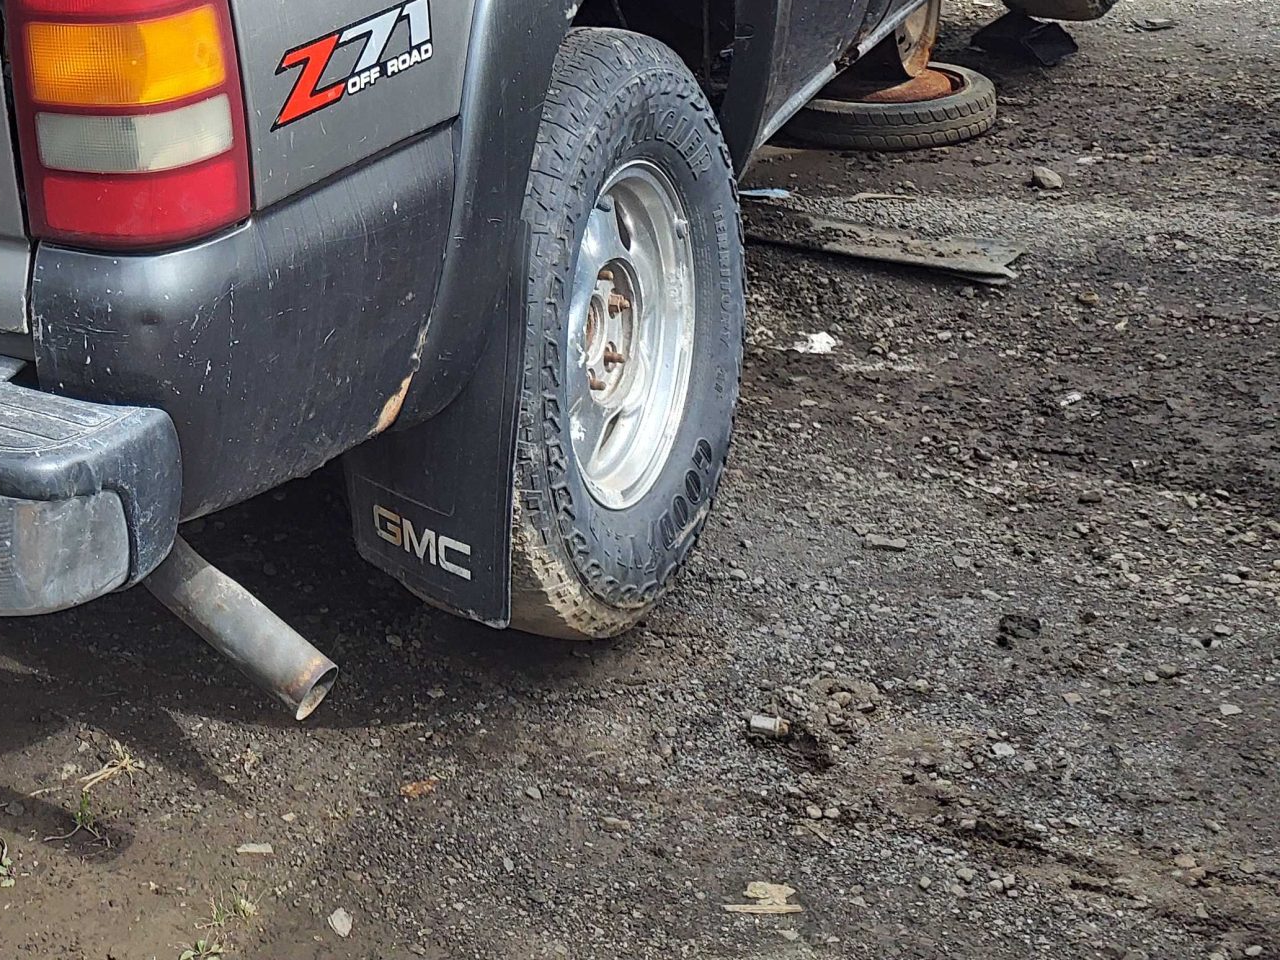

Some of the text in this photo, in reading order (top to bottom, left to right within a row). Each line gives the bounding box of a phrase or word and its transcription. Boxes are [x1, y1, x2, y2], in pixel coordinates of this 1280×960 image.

[347, 42, 434, 95] OFF ROAD
[373, 504, 471, 581] GMC
